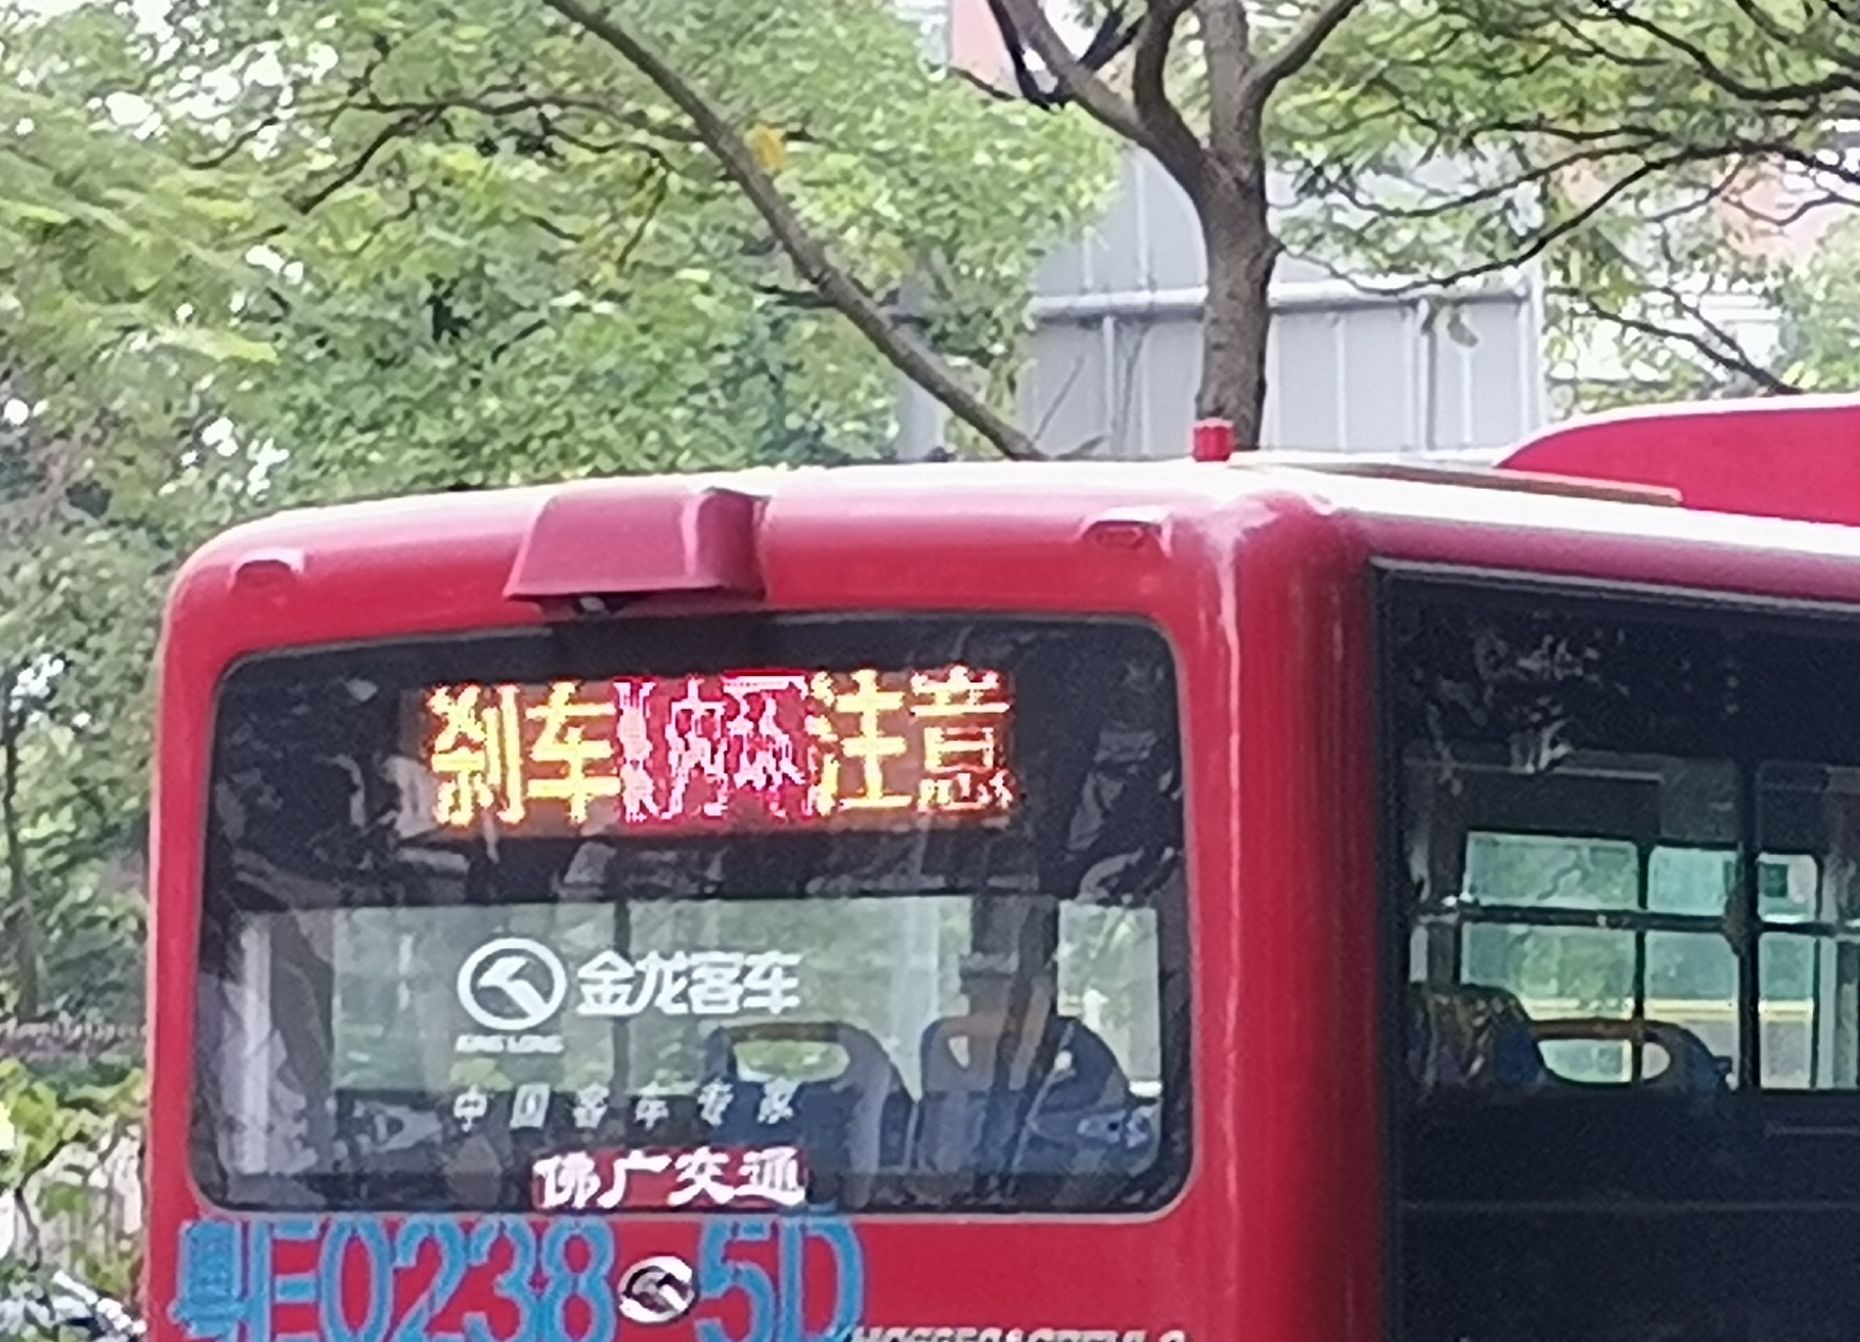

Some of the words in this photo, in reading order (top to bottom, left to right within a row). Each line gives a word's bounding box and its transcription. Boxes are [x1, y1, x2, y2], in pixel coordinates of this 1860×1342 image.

[576, 949, 801, 1015] 金龙客车
[533, 1146, 805, 1207] 佛广交通
